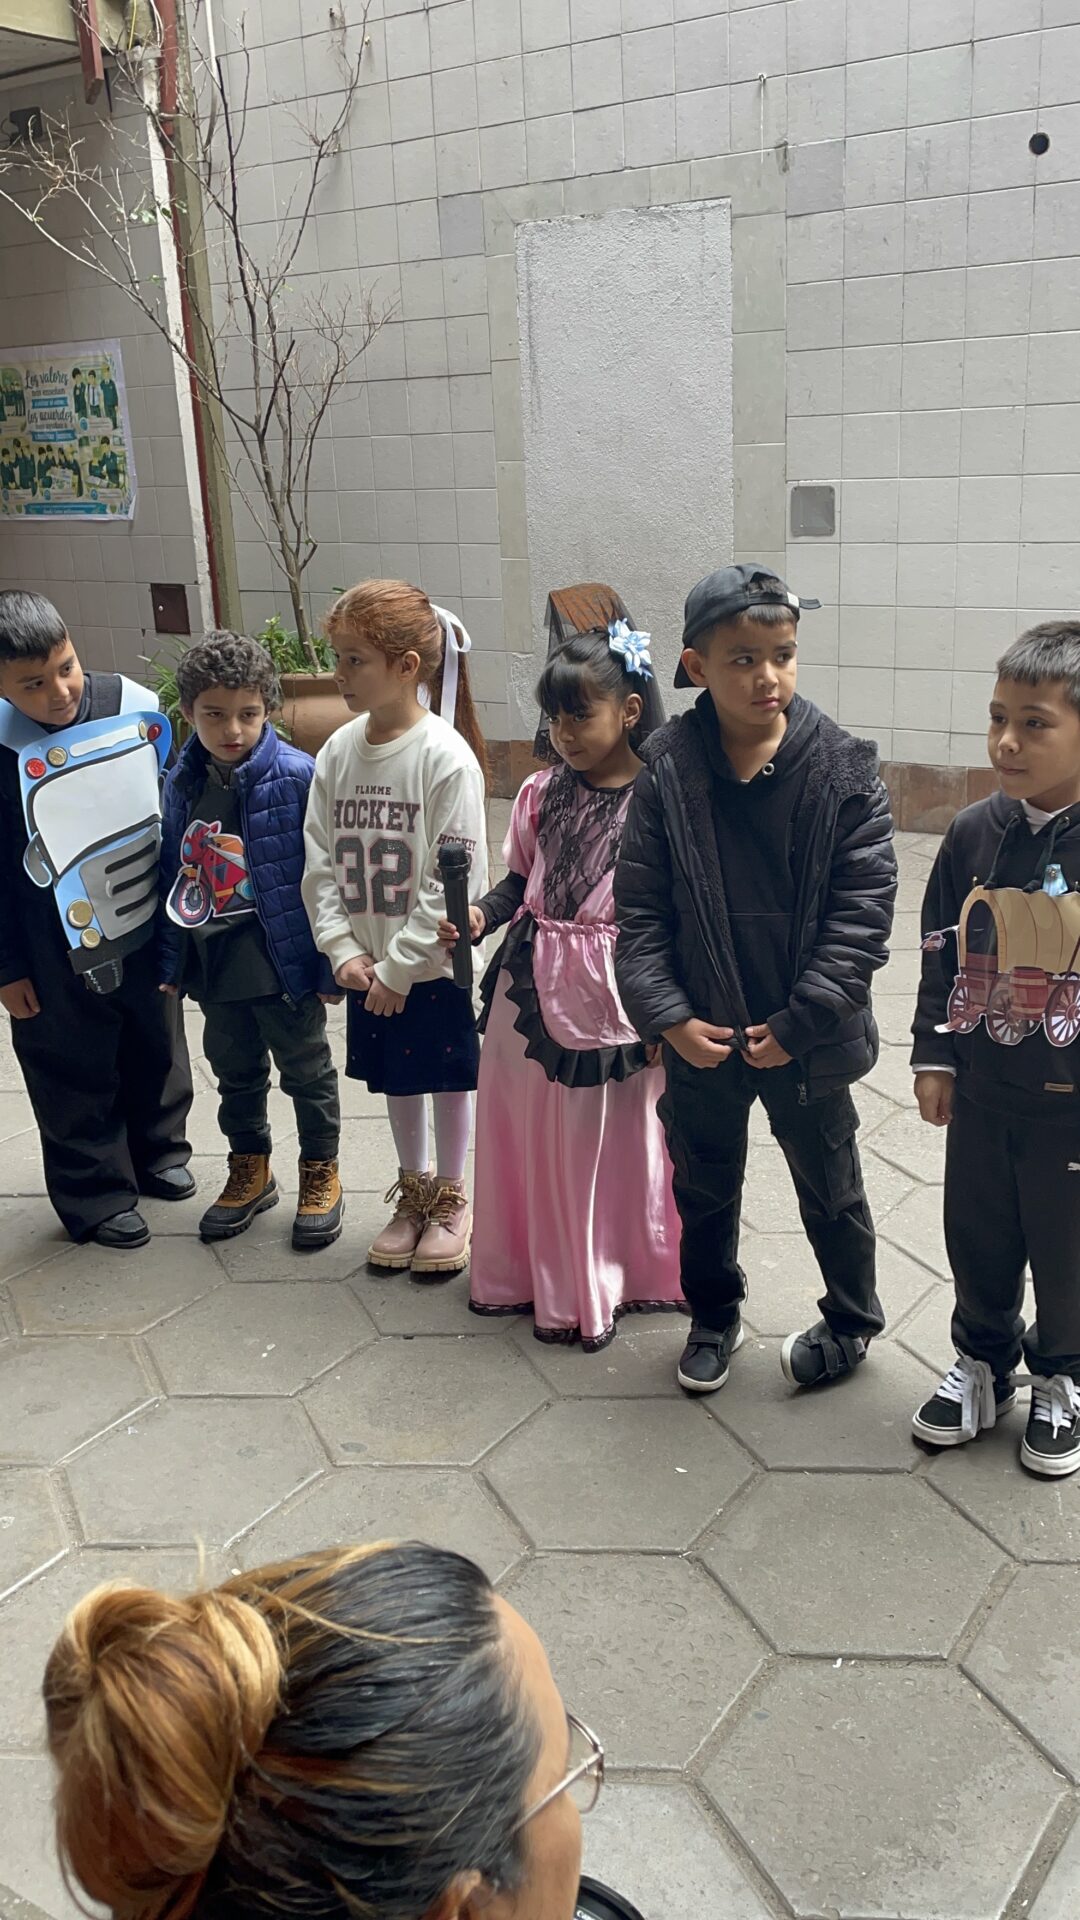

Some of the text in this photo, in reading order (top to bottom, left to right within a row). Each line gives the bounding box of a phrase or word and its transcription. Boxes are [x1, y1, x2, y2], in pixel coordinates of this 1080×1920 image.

[25, 366, 69, 389] Los valores
[40, 407, 73, 424] acuerdos
[355, 785, 392, 796] FLAMME
[334, 799, 421, 833] HOCKEY
[334, 835, 413, 918] 32
